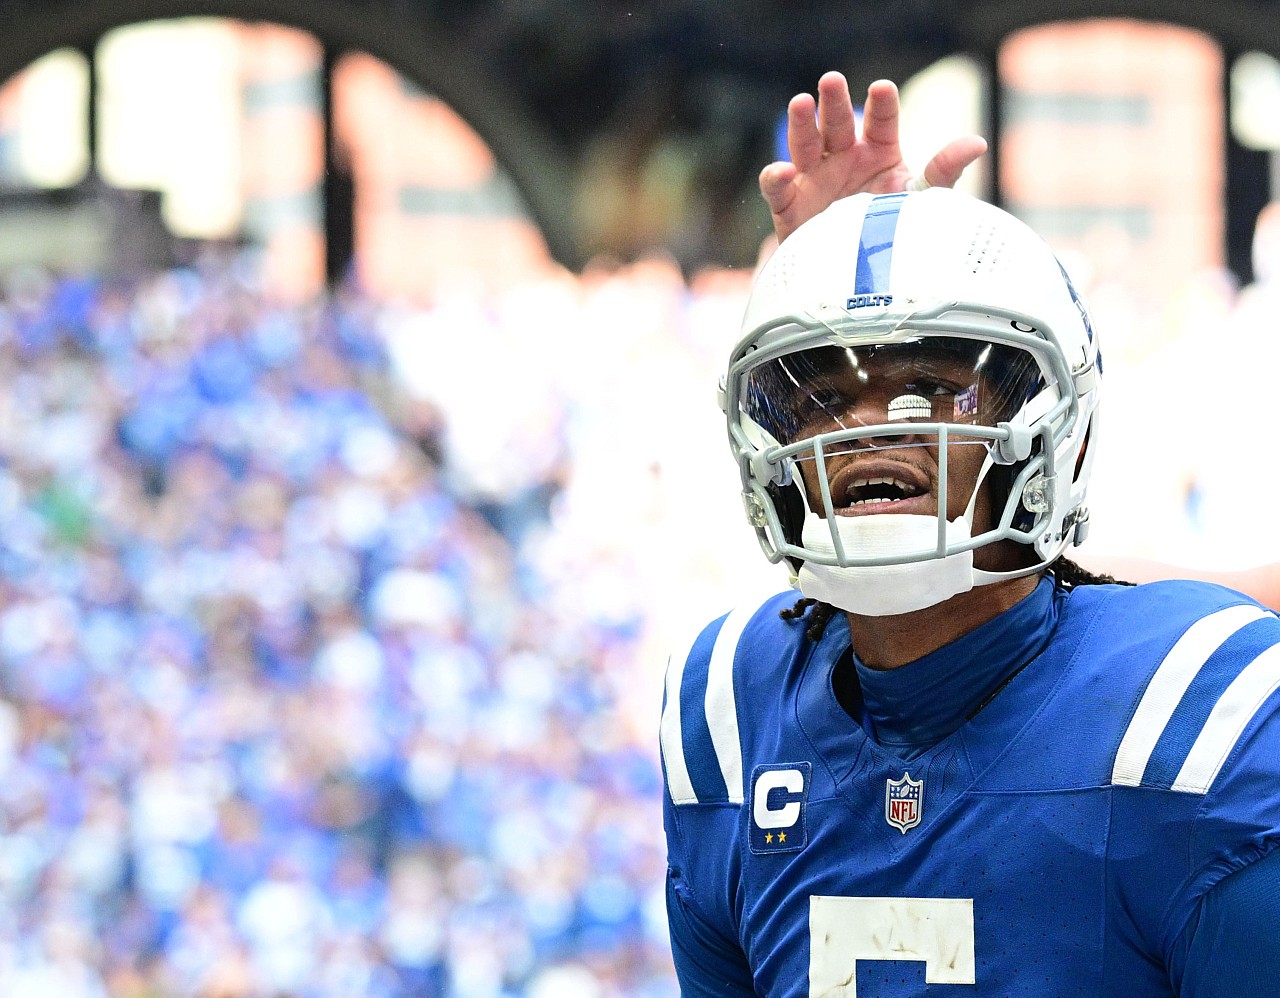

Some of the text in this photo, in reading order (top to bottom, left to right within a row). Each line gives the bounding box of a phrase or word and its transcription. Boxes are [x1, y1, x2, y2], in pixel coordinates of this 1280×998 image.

[846, 294, 893, 310] COLTS
[753, 769, 804, 829] C
[890, 800, 916, 823] NFL
